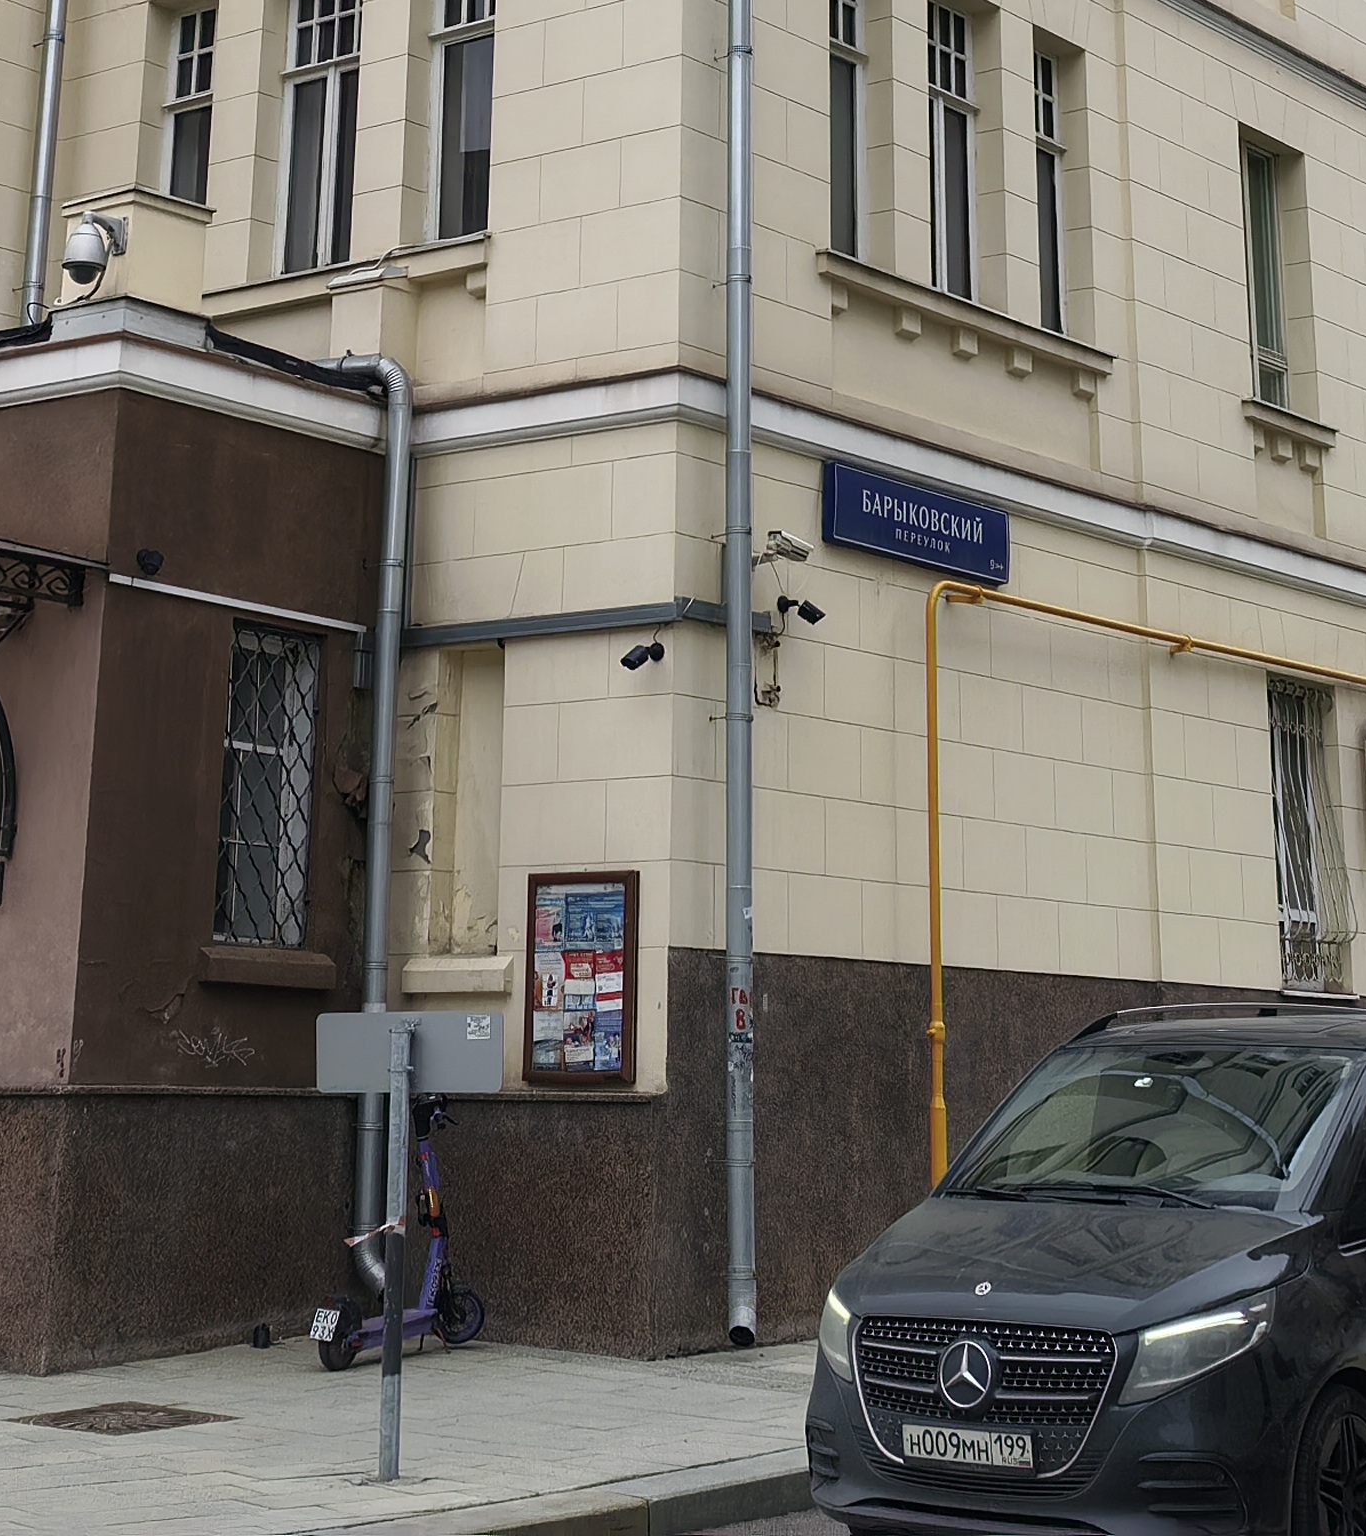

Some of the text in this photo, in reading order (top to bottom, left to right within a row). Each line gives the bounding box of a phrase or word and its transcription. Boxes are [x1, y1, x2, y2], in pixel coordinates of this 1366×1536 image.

[862, 489, 983, 545] БАРЫКОВСКИЙ
[895, 528, 951, 554] ПЕРЕУЛОК
[909, 1428, 1027, 1462] Н009МН 199
